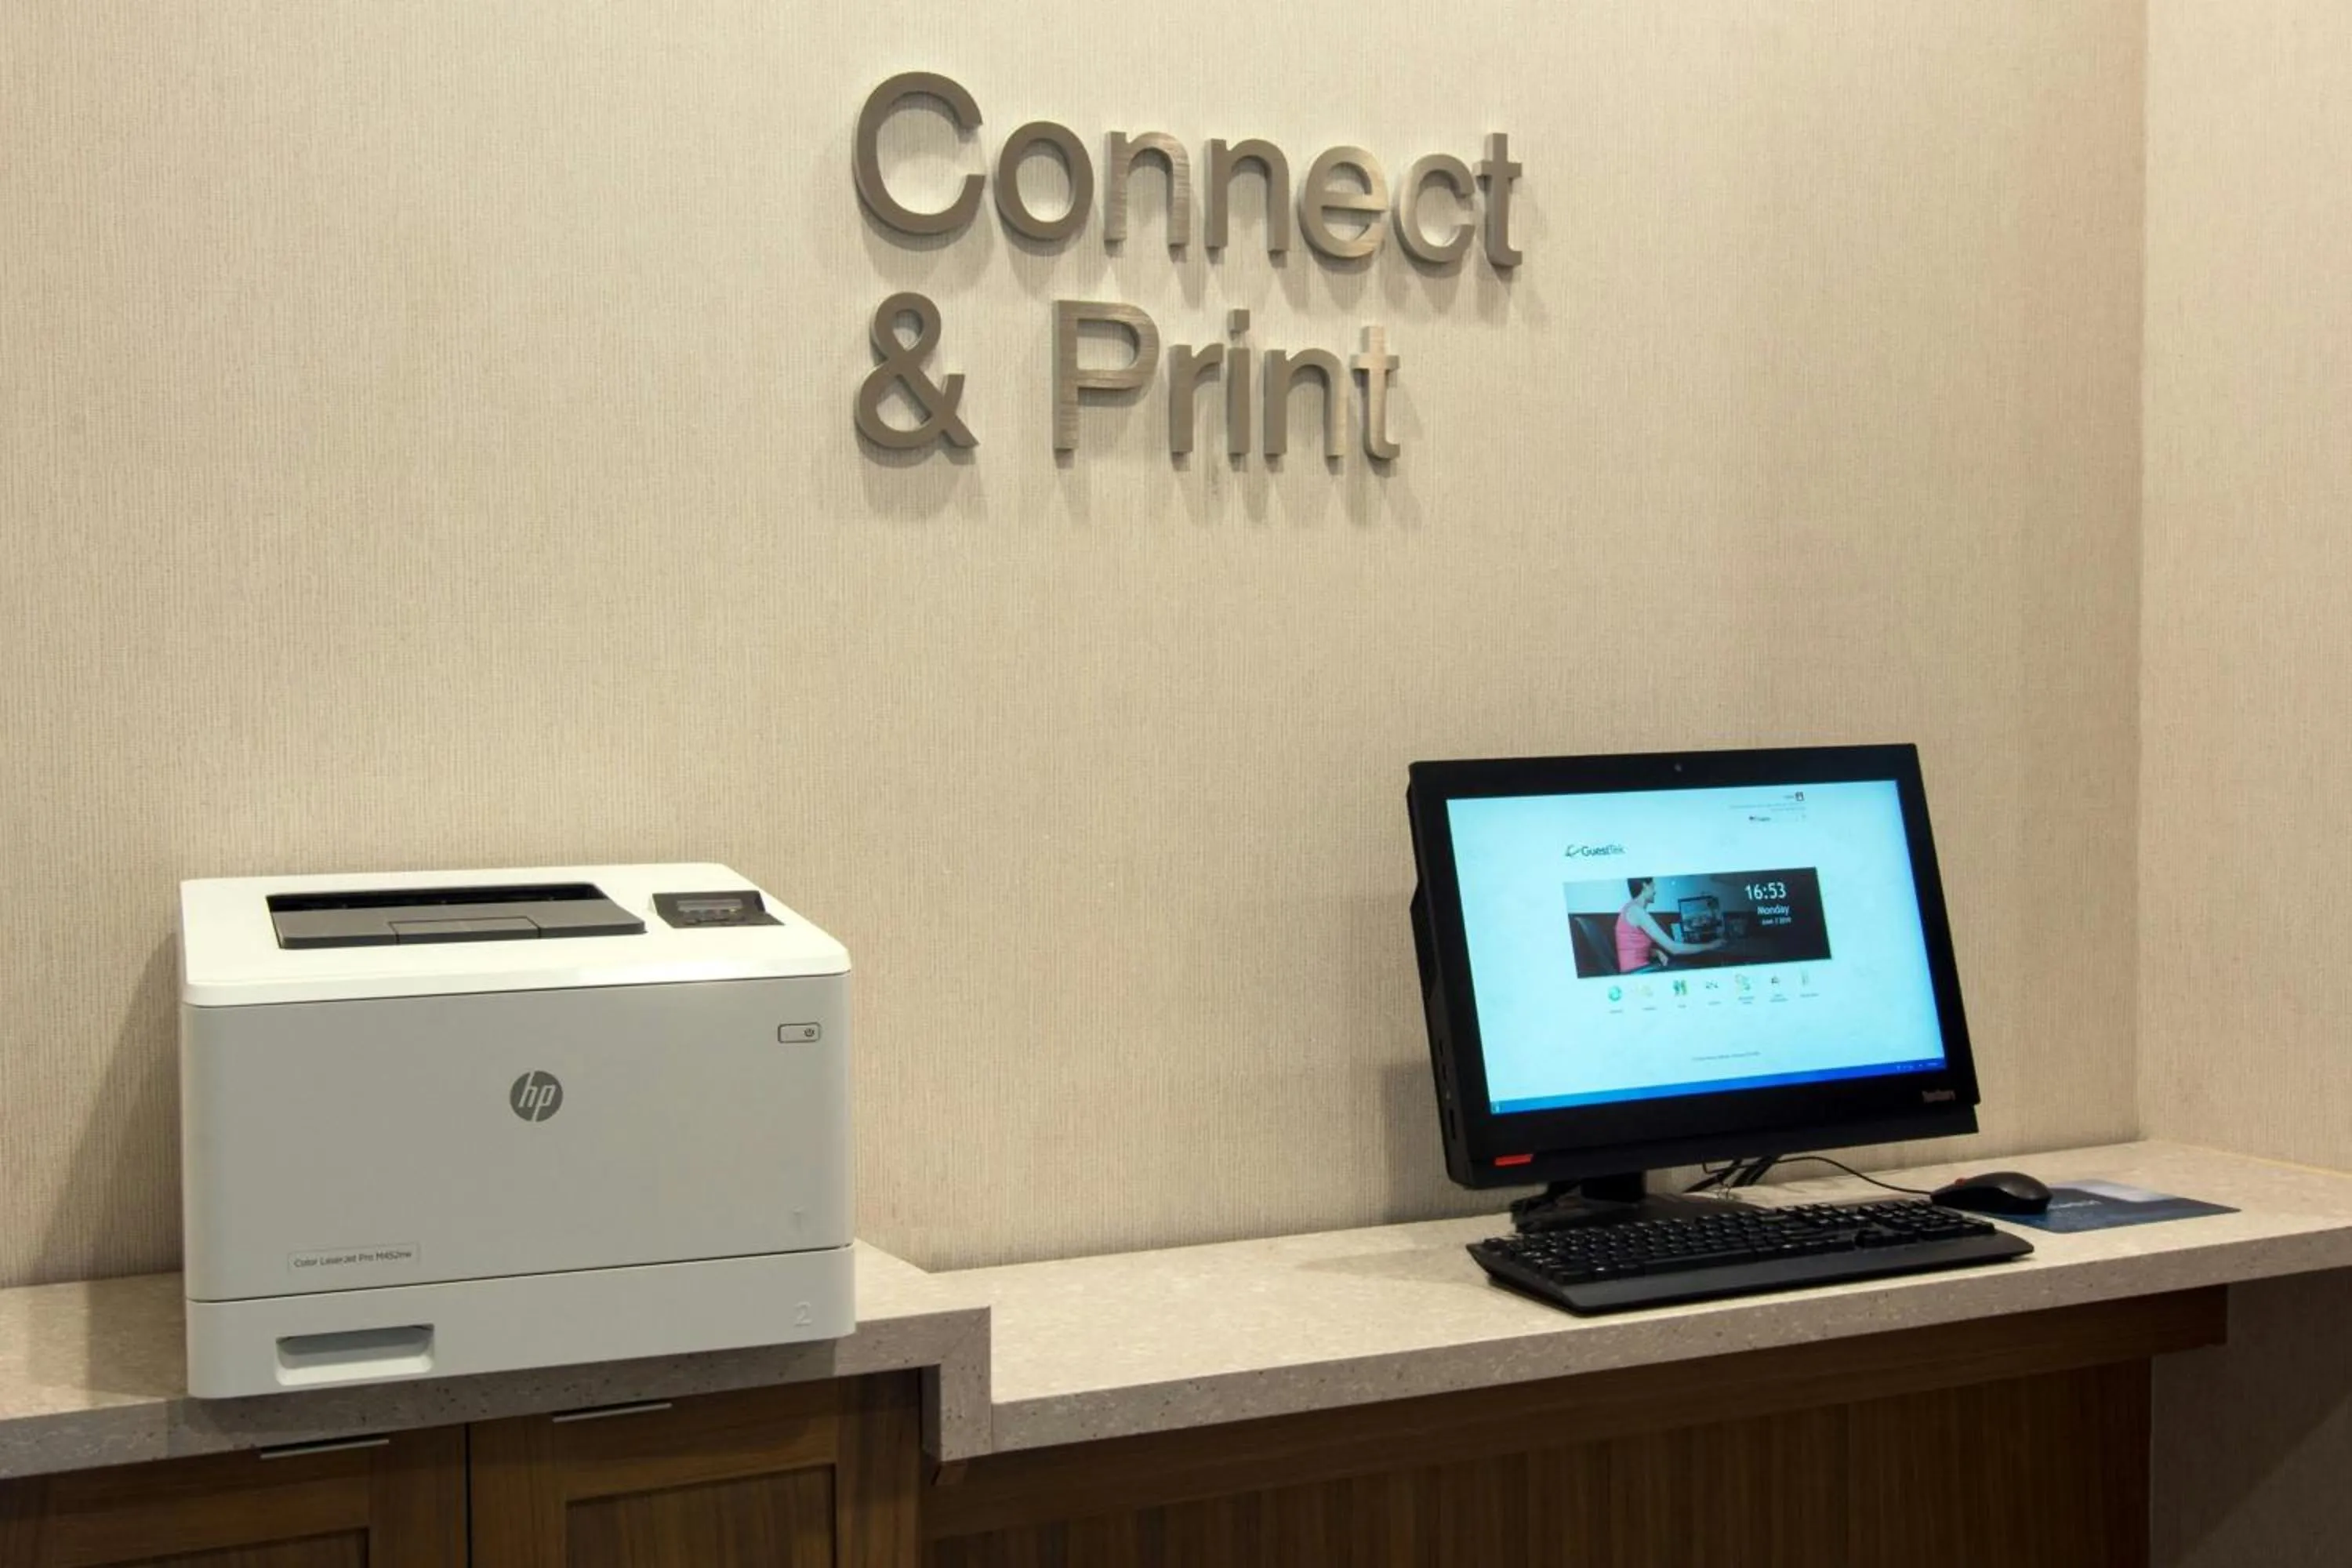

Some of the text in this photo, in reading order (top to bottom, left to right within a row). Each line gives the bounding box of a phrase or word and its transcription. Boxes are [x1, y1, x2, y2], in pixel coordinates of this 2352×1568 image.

[852, 71, 1523, 269] Connect
[854, 292, 1401, 462] & Print
[1744, 882, 1787, 901] 16:53
[1757, 904, 1790, 916] Monday
[517, 1070, 557, 1122] hp
[293, 1258, 318, 1268] Color
[793, 1301, 812, 1327] 2
